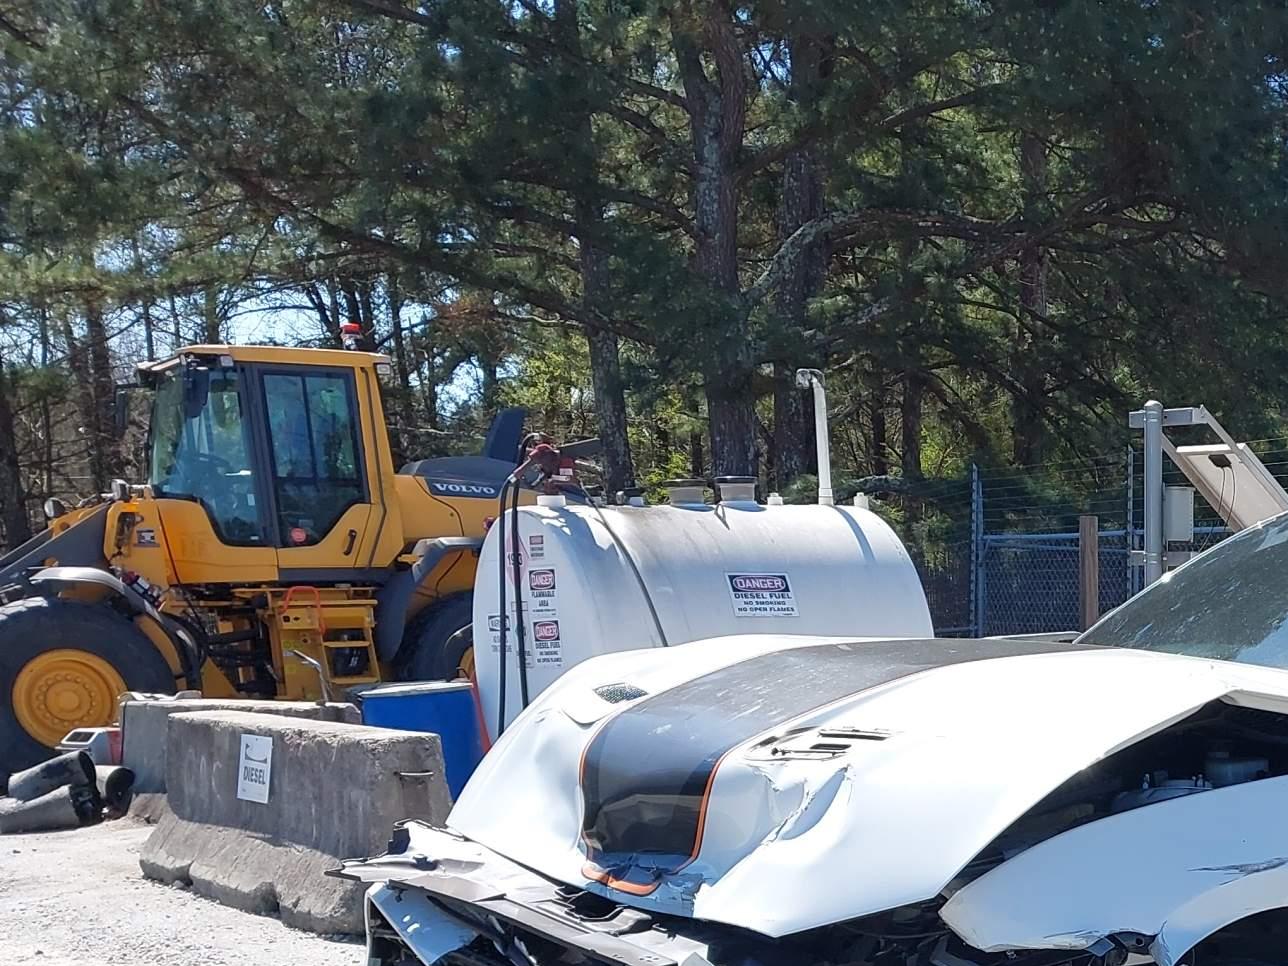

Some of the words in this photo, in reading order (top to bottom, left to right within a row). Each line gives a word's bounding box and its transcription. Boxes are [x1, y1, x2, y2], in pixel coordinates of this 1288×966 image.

[432, 483, 496, 494] VOLVO
[531, 575, 554, 585] DANGER
[737, 578, 782, 588] DANGER
[536, 626, 558, 636] DANGER
[243, 765, 266, 785] DIESEL
